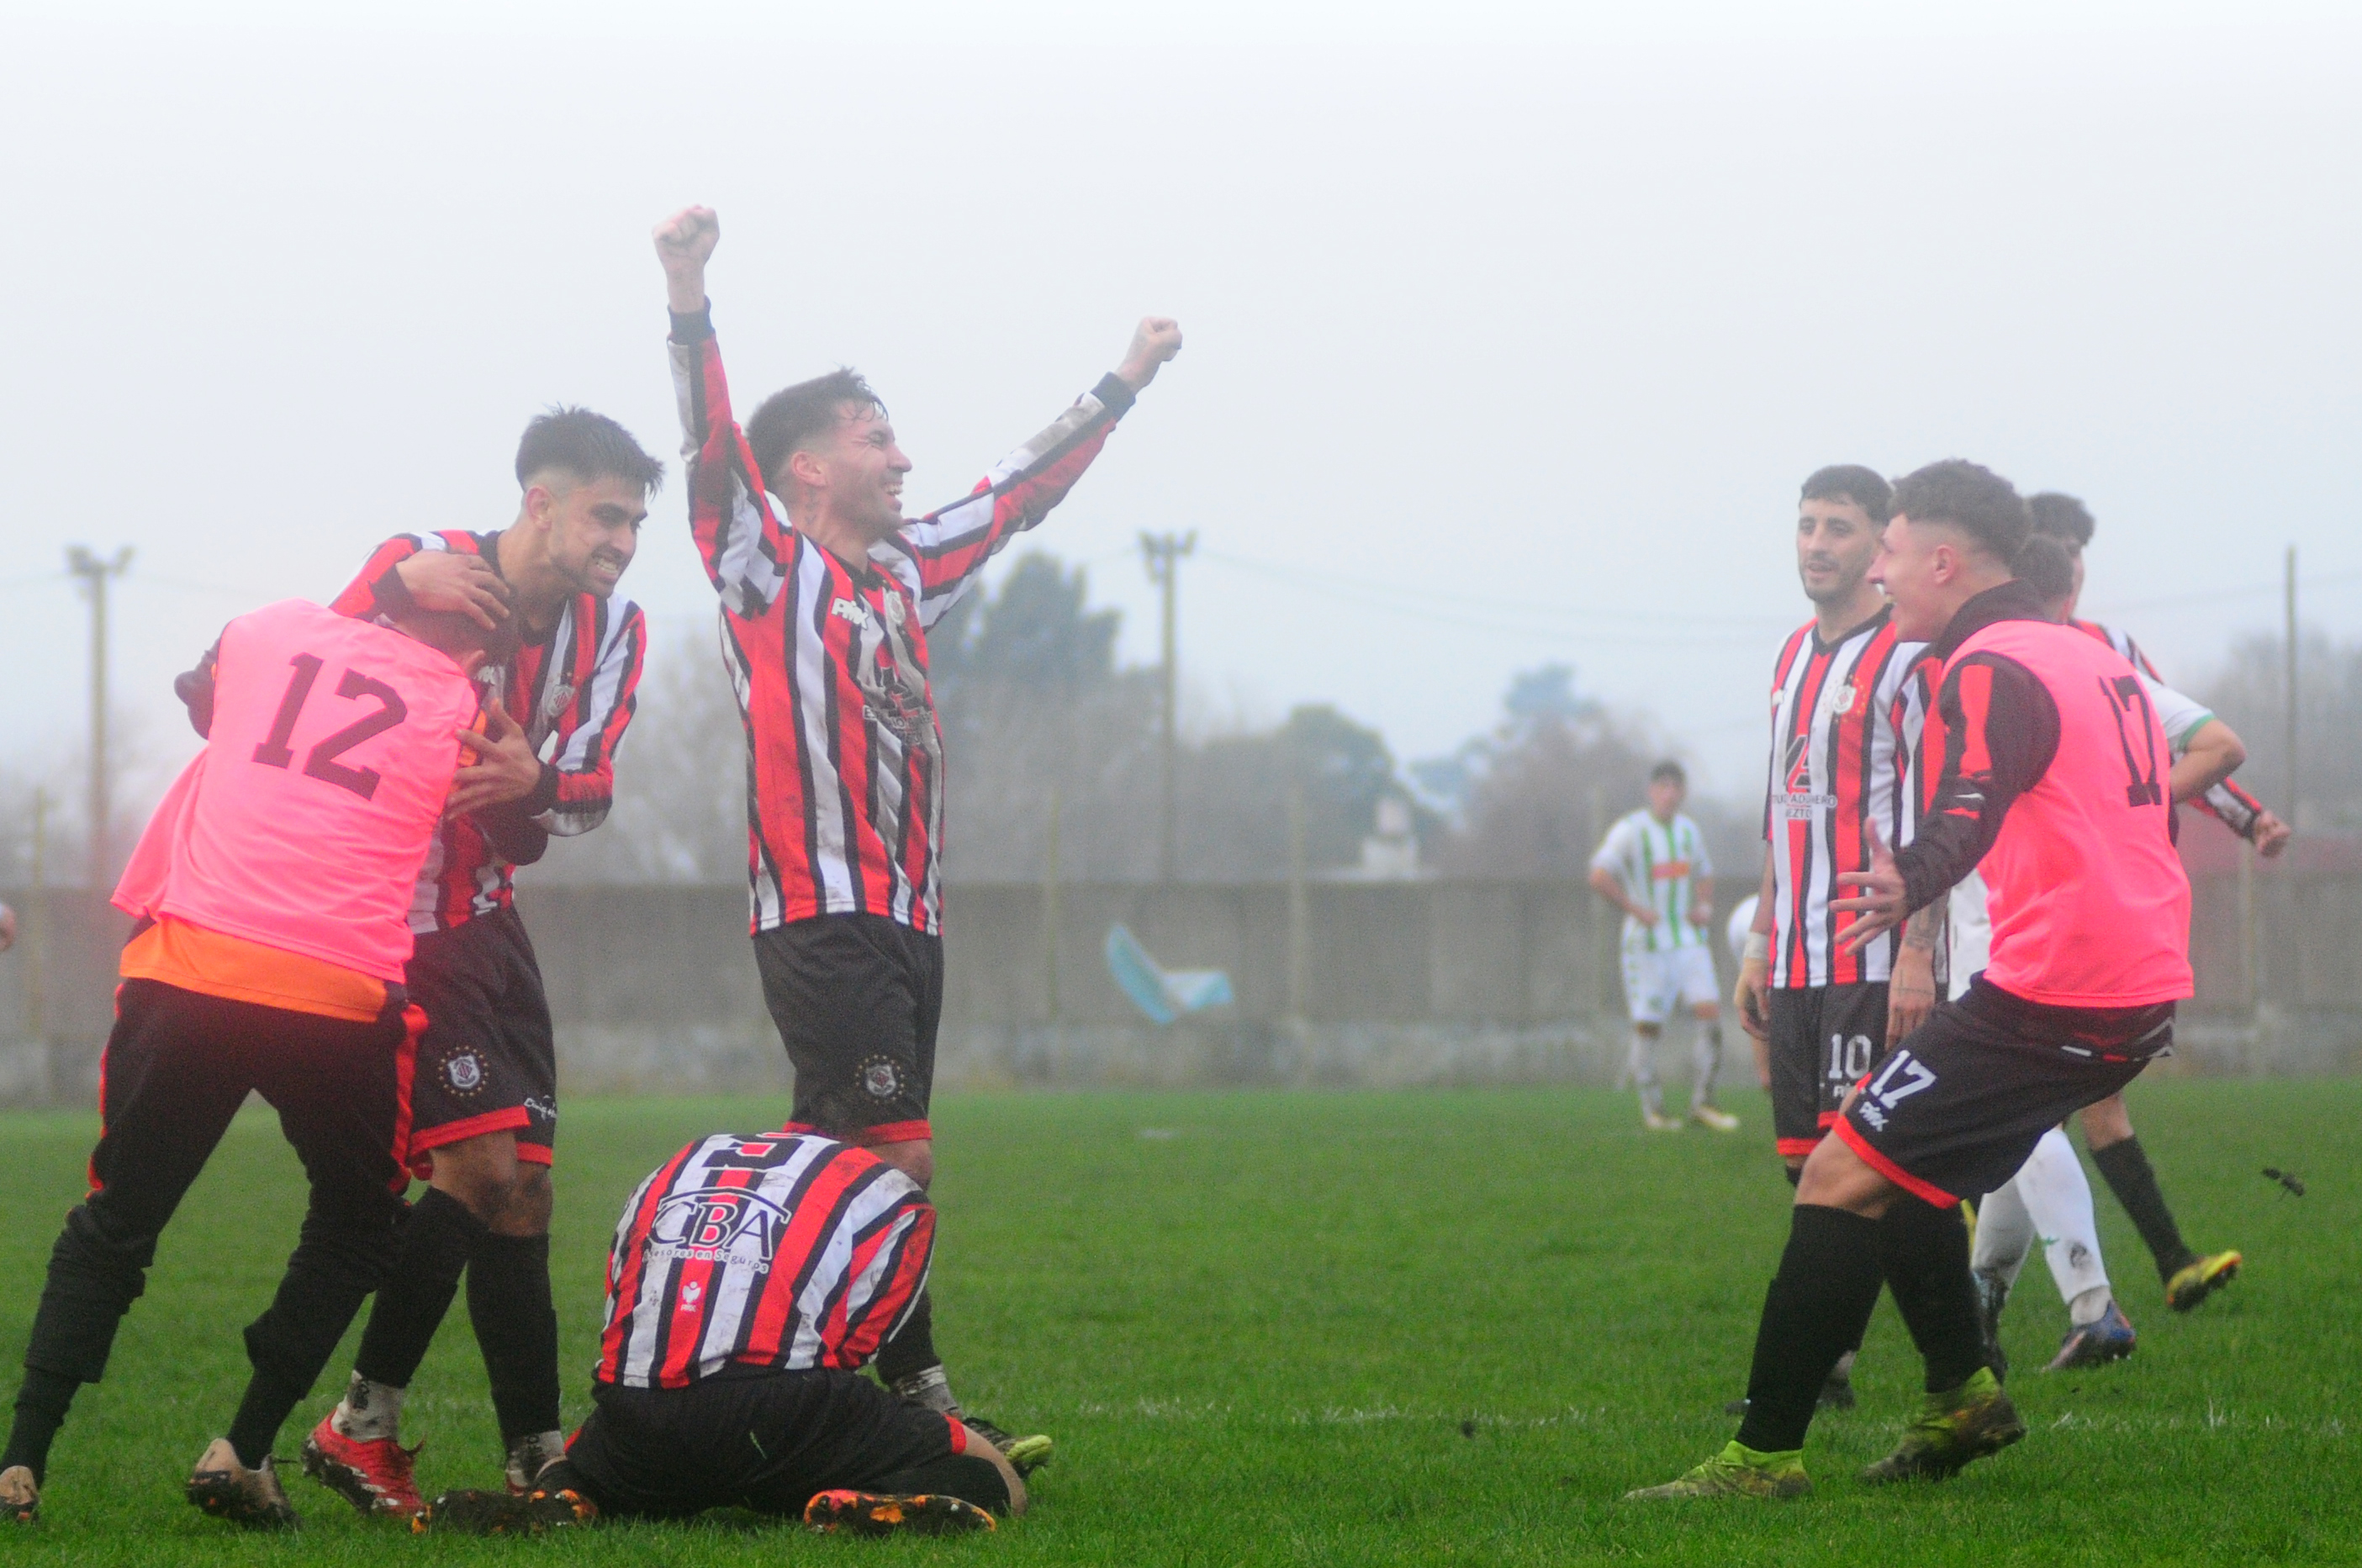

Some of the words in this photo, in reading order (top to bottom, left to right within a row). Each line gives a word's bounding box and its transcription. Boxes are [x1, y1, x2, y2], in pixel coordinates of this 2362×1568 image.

[252, 652, 408, 801] 12
[2096, 674, 2163, 808] 17
[1828, 1033, 1873, 1080] 10
[1870, 1049, 1937, 1110] 17
[647, 1201, 773, 1261] CBA
[696, 1249, 712, 1260] en
[715, 1249, 769, 1274] Seguros
